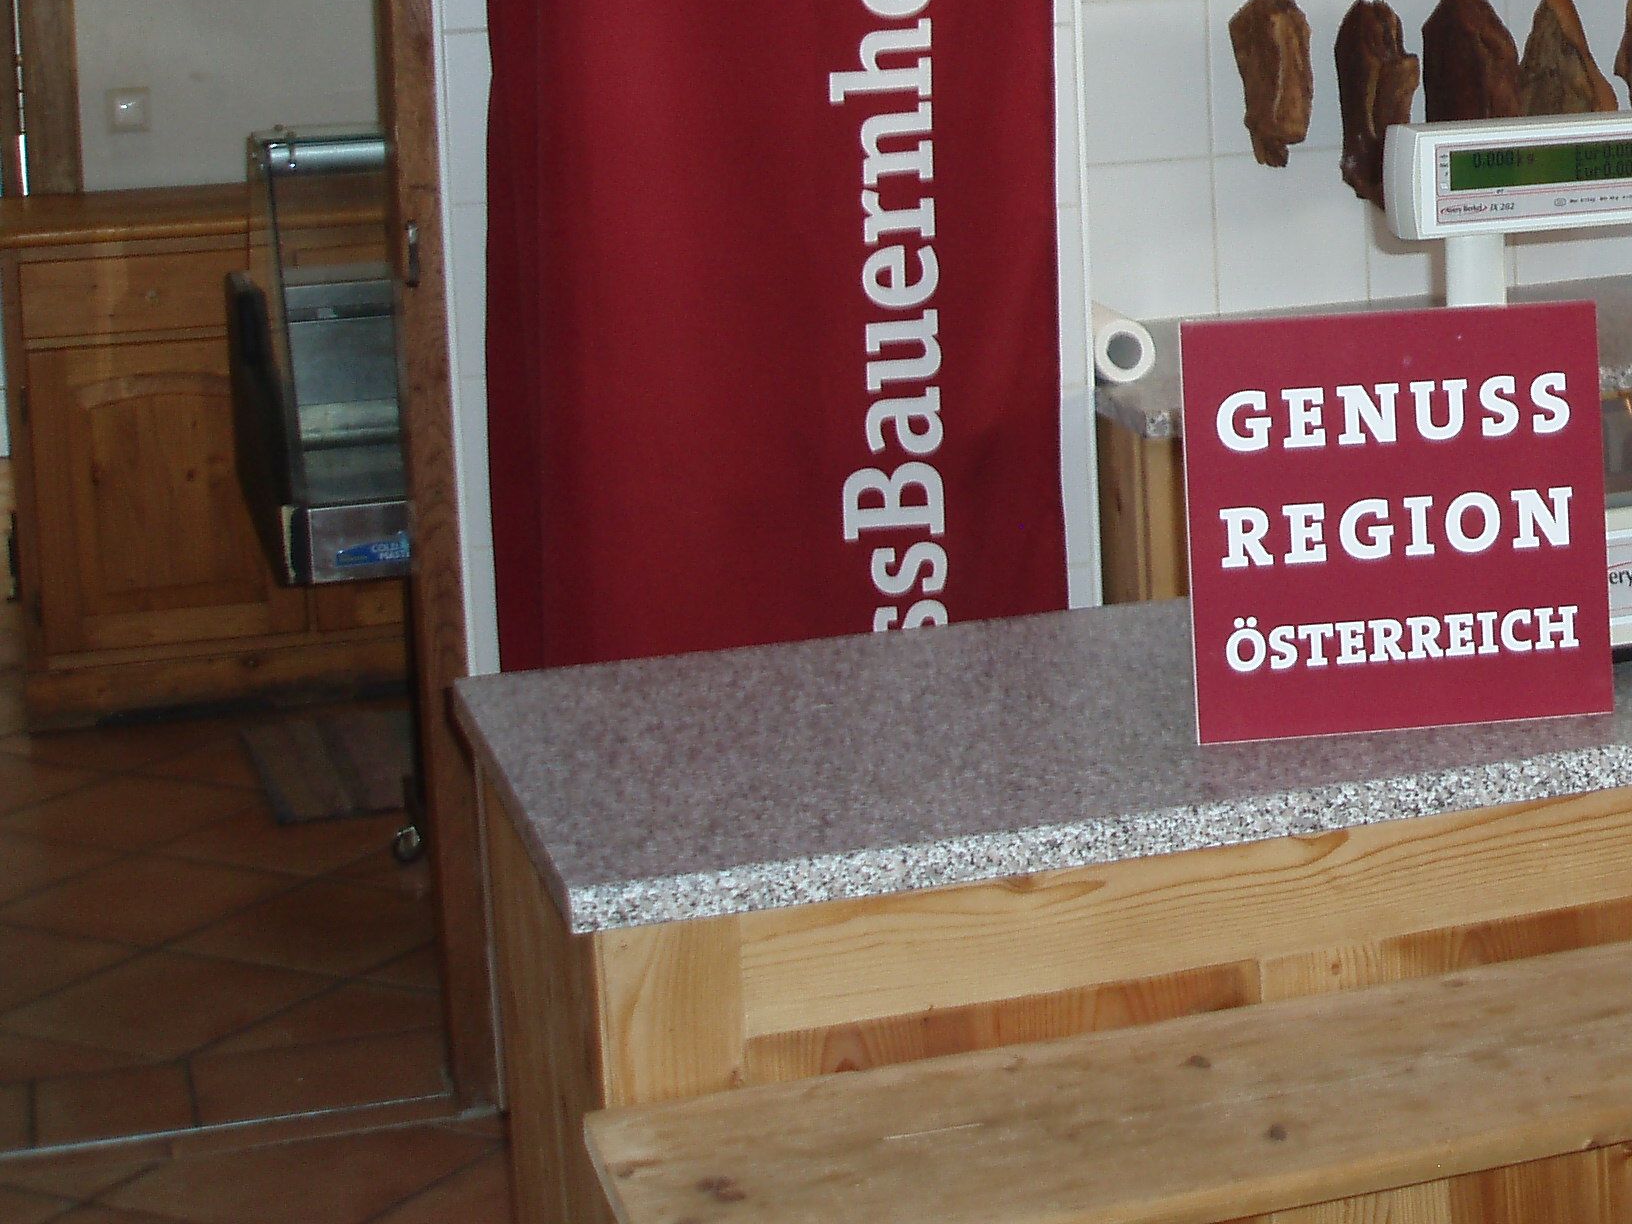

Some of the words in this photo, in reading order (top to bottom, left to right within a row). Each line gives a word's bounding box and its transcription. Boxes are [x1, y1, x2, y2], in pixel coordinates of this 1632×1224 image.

[1216, 372, 1571, 452] GENUSS
[1219, 486, 1573, 569] REGION
[1225, 605, 1580, 673] ÖSTERREICH
